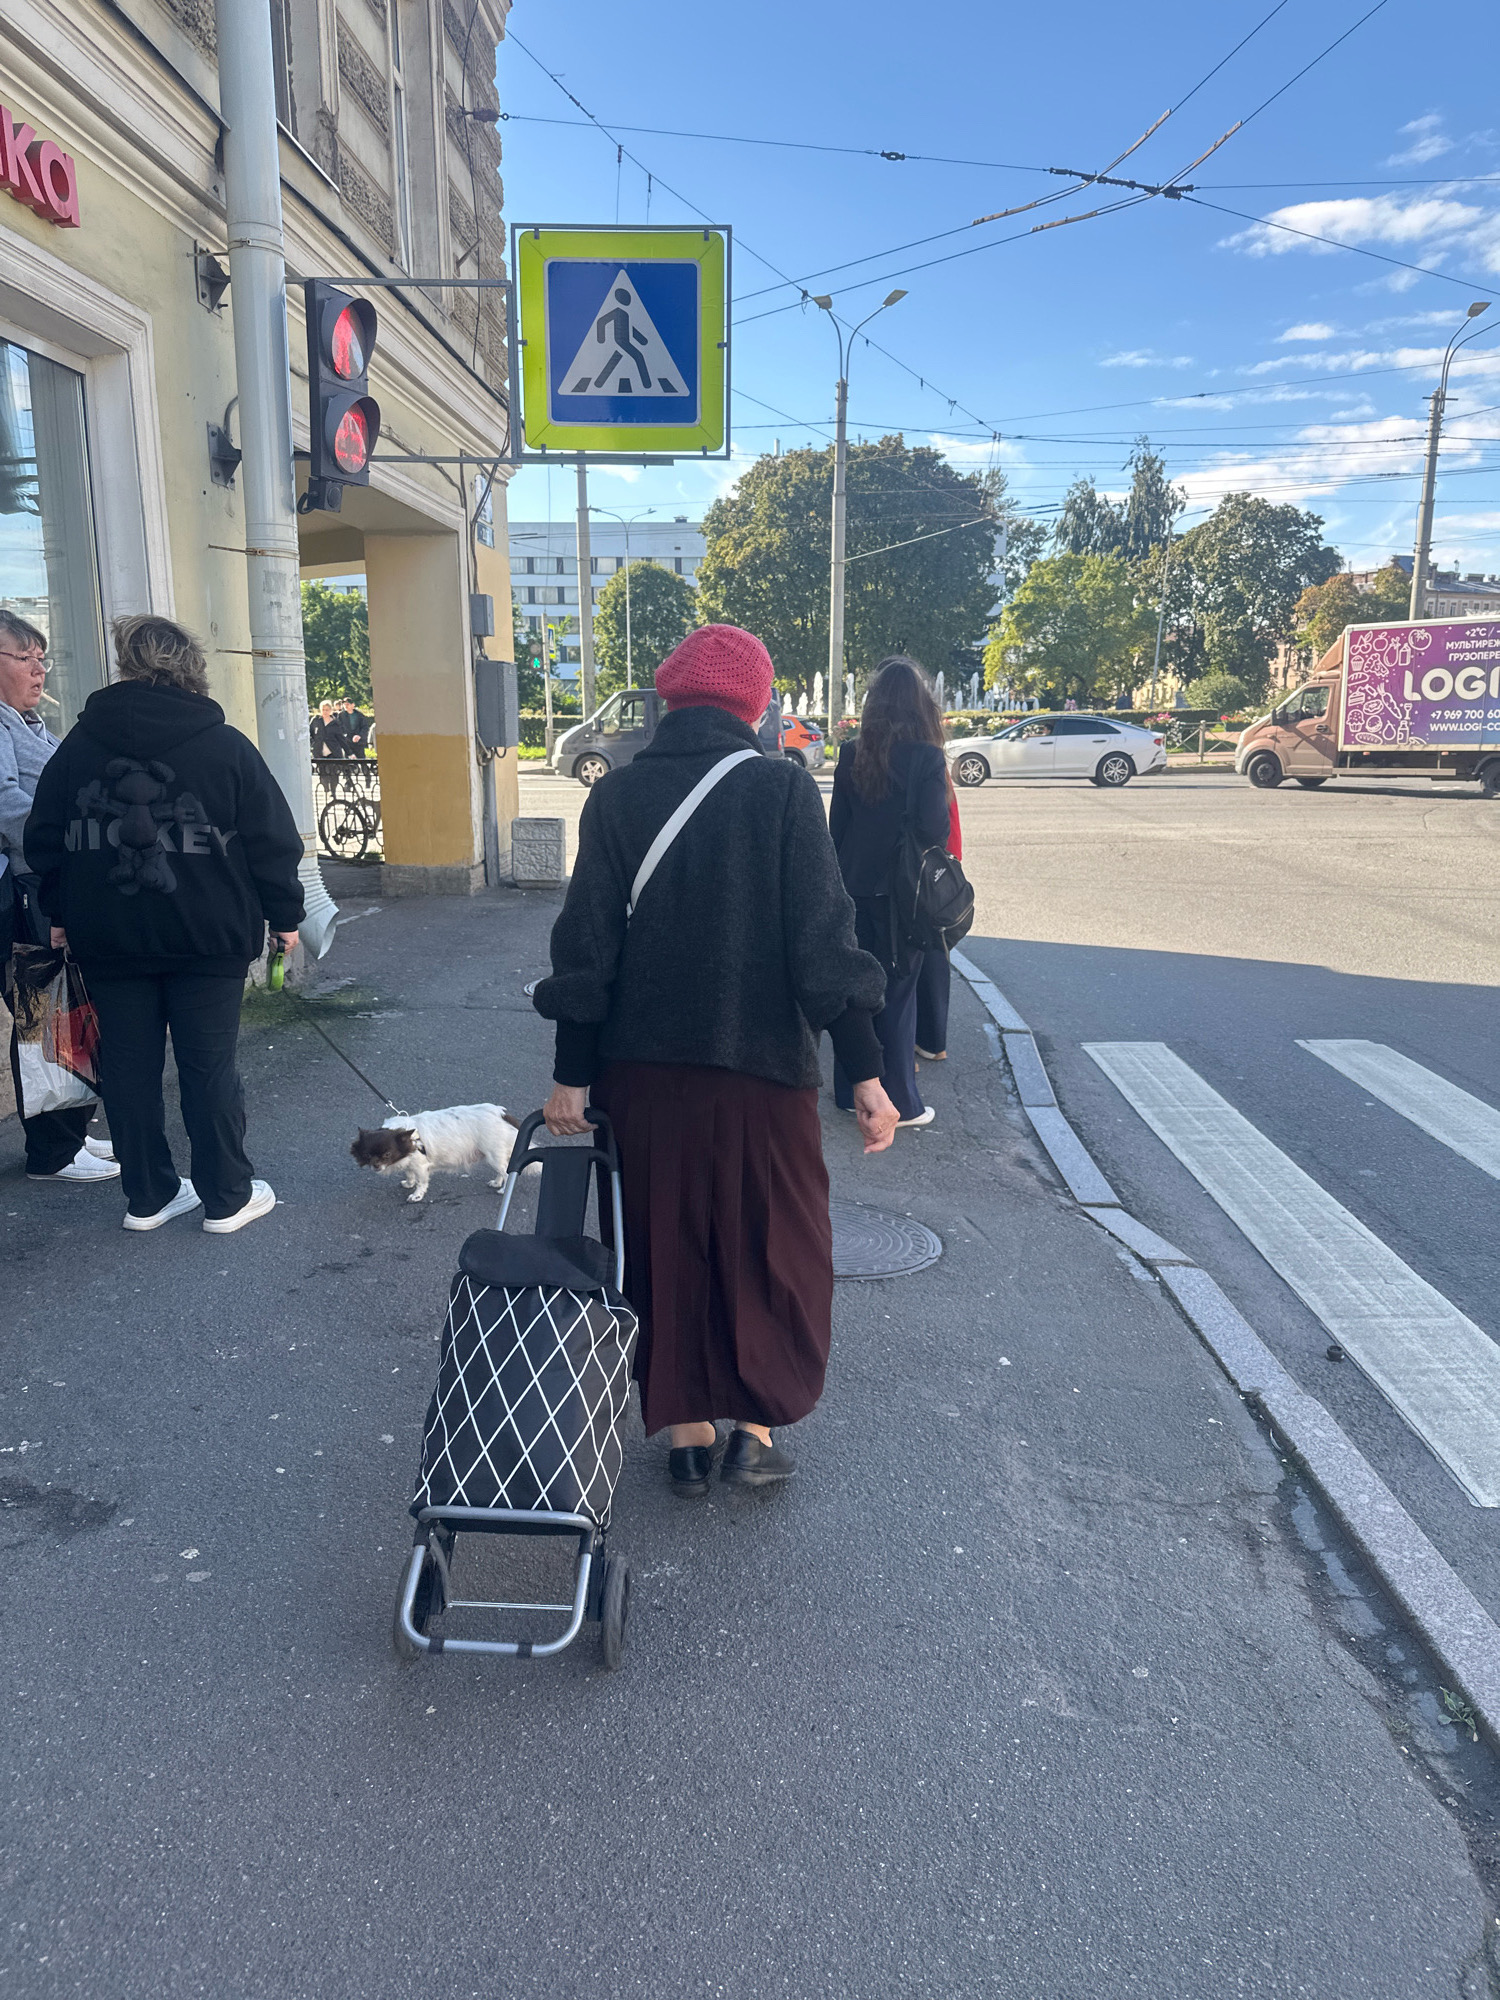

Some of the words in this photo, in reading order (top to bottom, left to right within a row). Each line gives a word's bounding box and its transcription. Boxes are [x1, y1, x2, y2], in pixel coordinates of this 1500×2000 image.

[0, 104, 80, 228] ка
[1449, 650, 1500, 661] ГРУЗОПЕРЕ
[1403, 666, 1500, 701] LOGI
[1430, 710, 1442, 720] +7
[1444, 710, 1463, 720] 969
[1464, 709, 1484, 719] 700
[1487, 709, 1500, 719] 60
